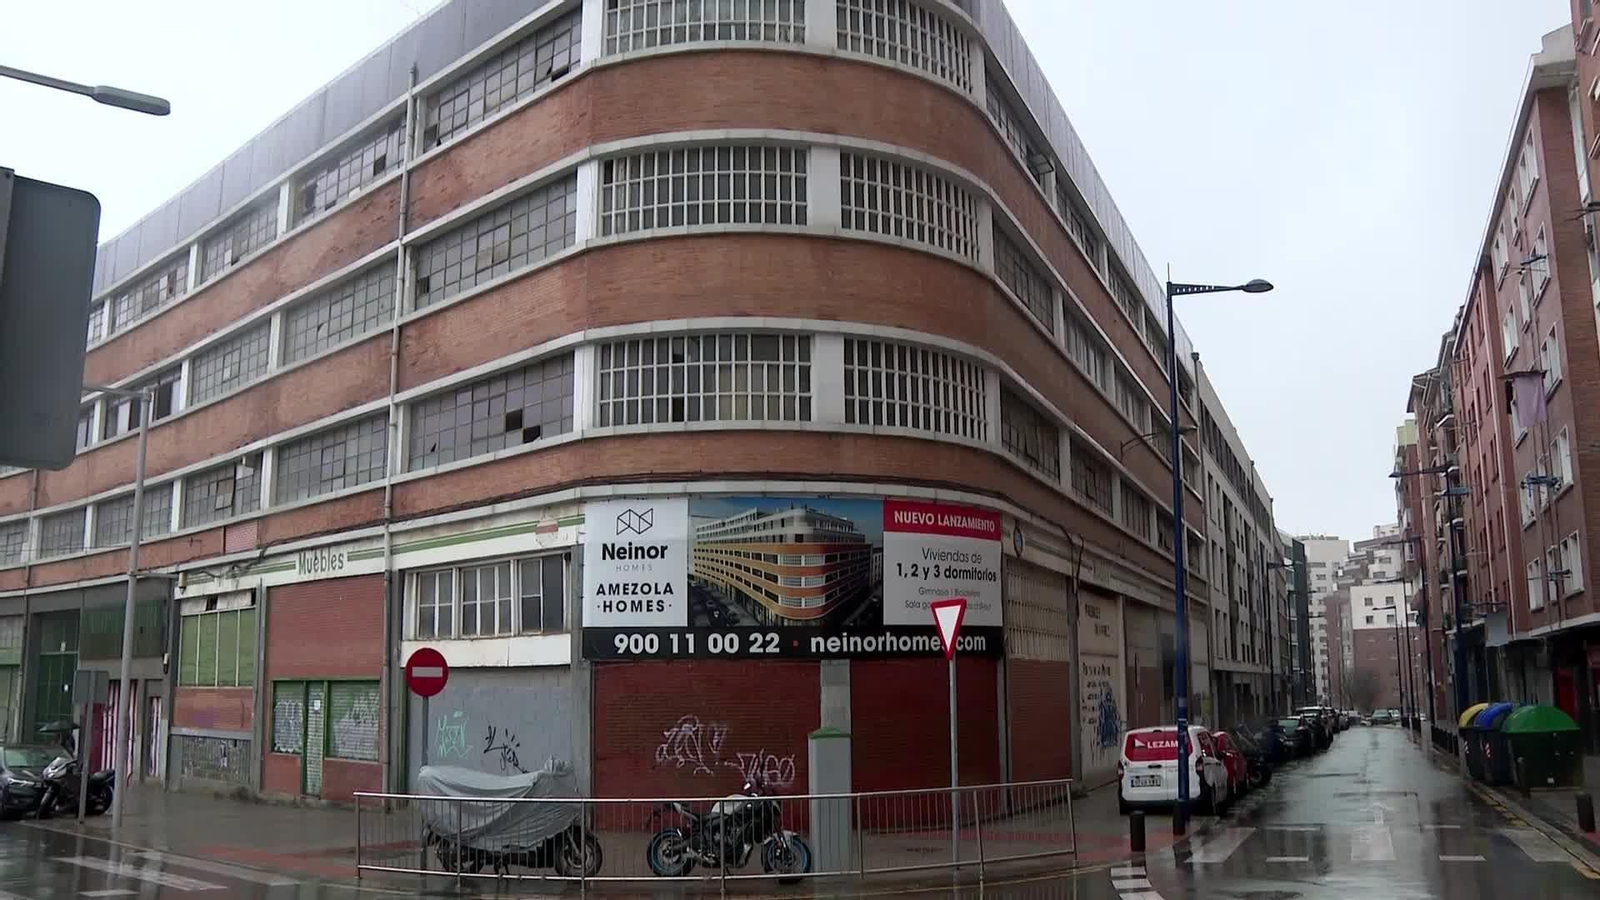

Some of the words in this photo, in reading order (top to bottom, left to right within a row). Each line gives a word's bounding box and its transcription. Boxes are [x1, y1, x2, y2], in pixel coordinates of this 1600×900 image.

[894, 511, 935, 525] NUEVO
[938, 514, 995, 532] LANZAMIENTO
[602, 541, 668, 560] Neinor
[922, 547, 969, 563] Viviendas
[299, 547, 344, 574] Muebles
[923, 566, 930, 580] y
[934, 565, 941, 578] 3
[944, 565, 997, 581] dormitorios
[596, 582, 674, 596] AMEZOLA
[614, 633, 660, 654] 900
[669, 633, 695, 654] 11
[707, 633, 740, 654] 00
[749, 632, 780, 654] 22
[810, 631, 986, 653] neinorhomecom
[1147, 740, 1179, 749] LEZAM
